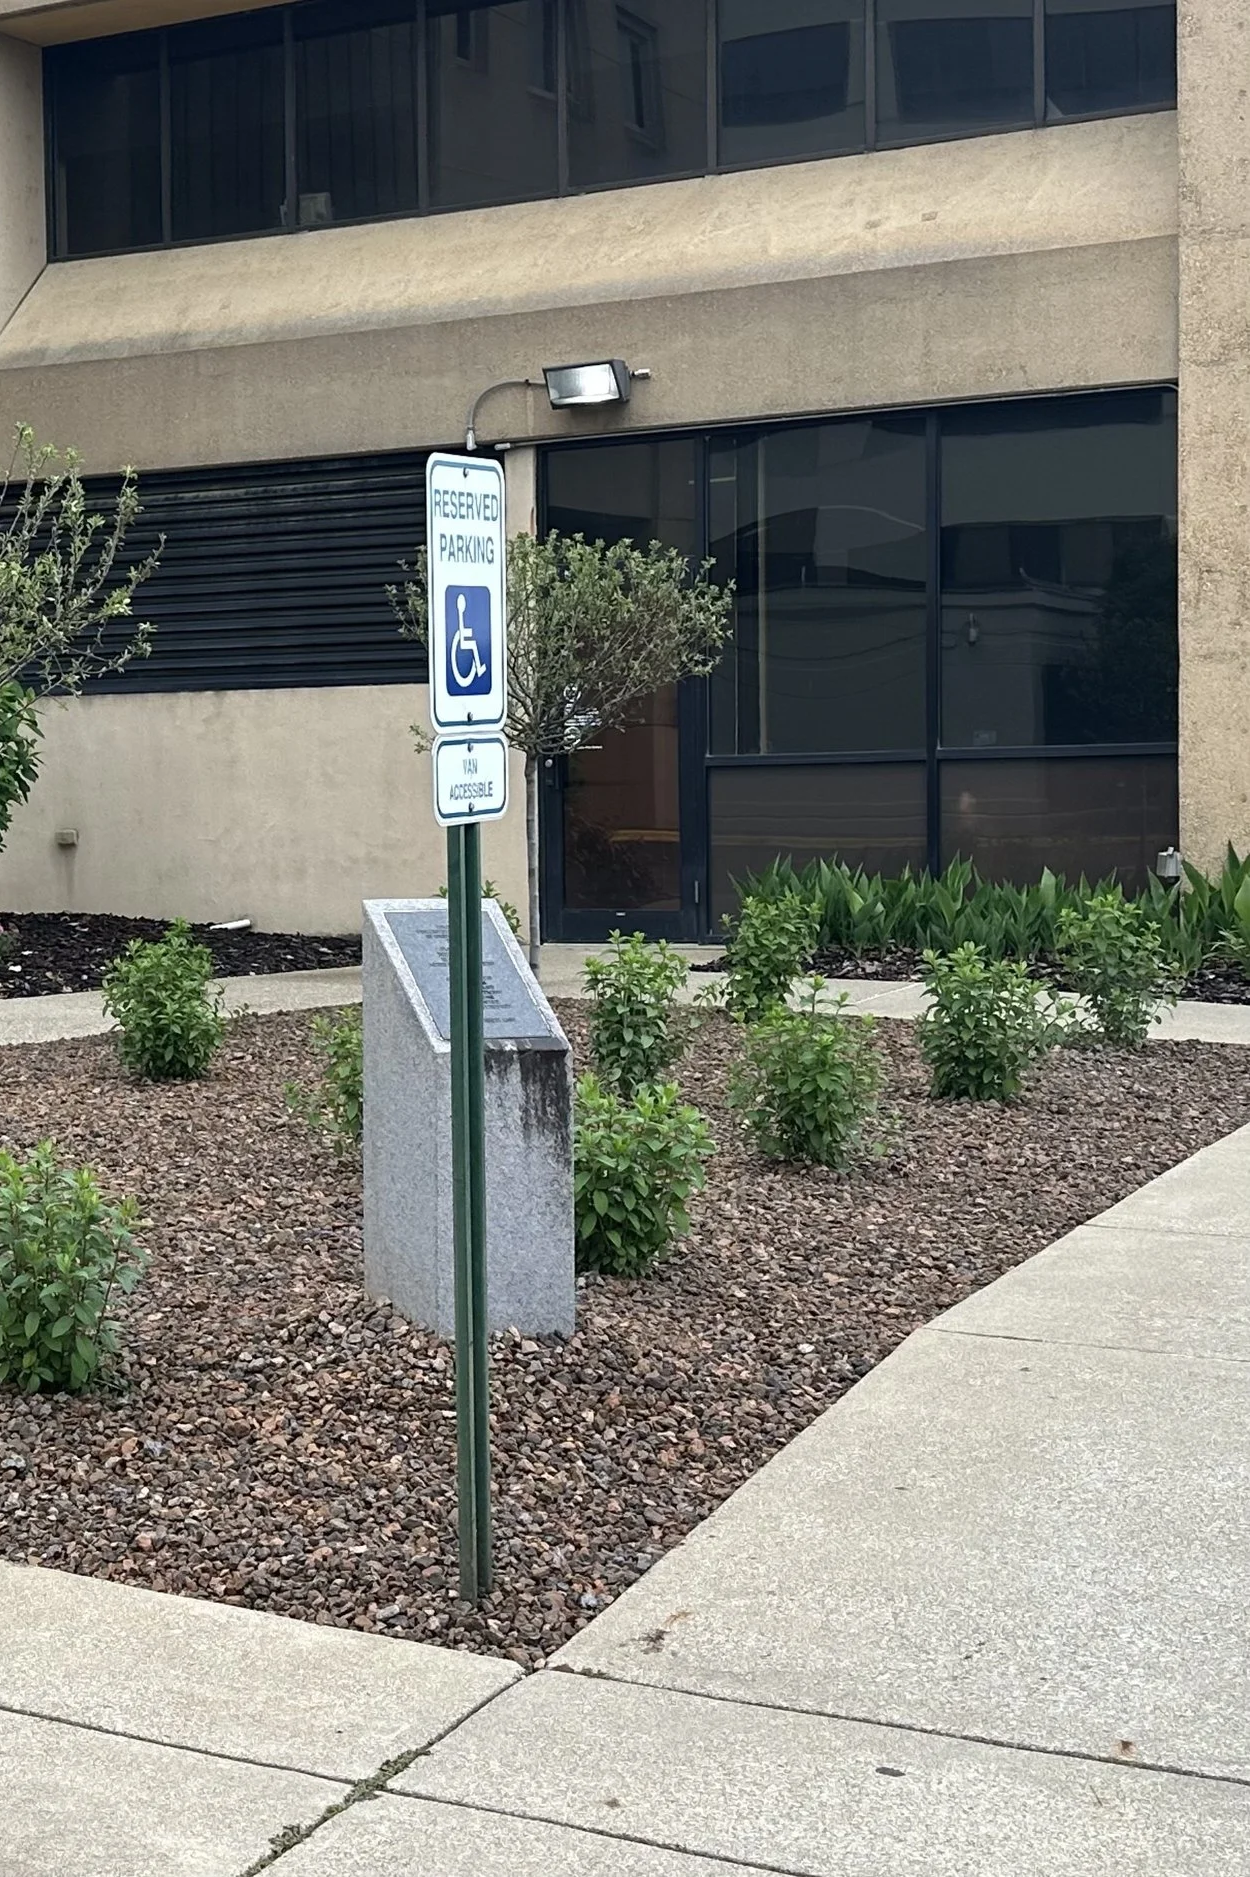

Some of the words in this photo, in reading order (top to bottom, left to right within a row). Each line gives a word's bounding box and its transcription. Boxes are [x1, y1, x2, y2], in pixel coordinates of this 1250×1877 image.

[434, 488, 498, 522] RESERVED
[439, 533, 494, 565] PARKING
[462, 758, 478, 775] VAN
[449, 781, 493, 800] ACCESSIBLE
